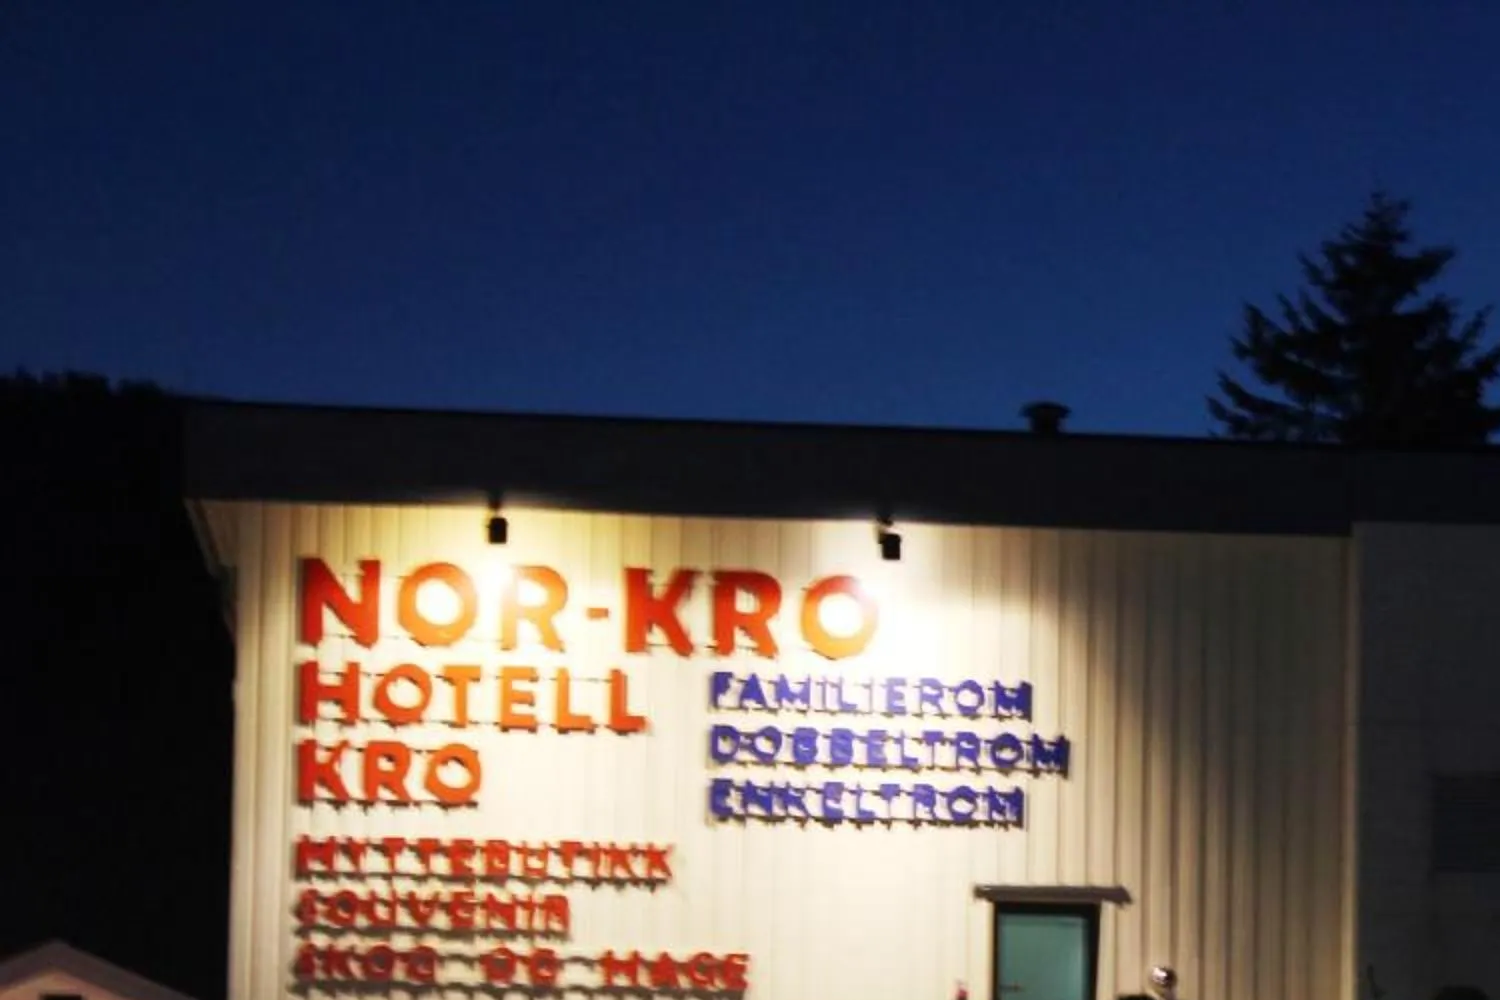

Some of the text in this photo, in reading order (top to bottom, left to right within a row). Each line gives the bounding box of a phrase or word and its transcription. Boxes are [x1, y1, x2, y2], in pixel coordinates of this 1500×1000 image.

[299, 556, 880, 661] NOR-KRO
[298, 660, 648, 733] HOTELL
[710, 671, 1033, 718] FAMILIEROM
[297, 738, 481, 808] KRO
[710, 724, 1070, 776] DOBBELTROM
[709, 777, 1024, 826] ENKELTROM
[478, 944, 560, 986] OG
[598, 948, 750, 992] HAGE
